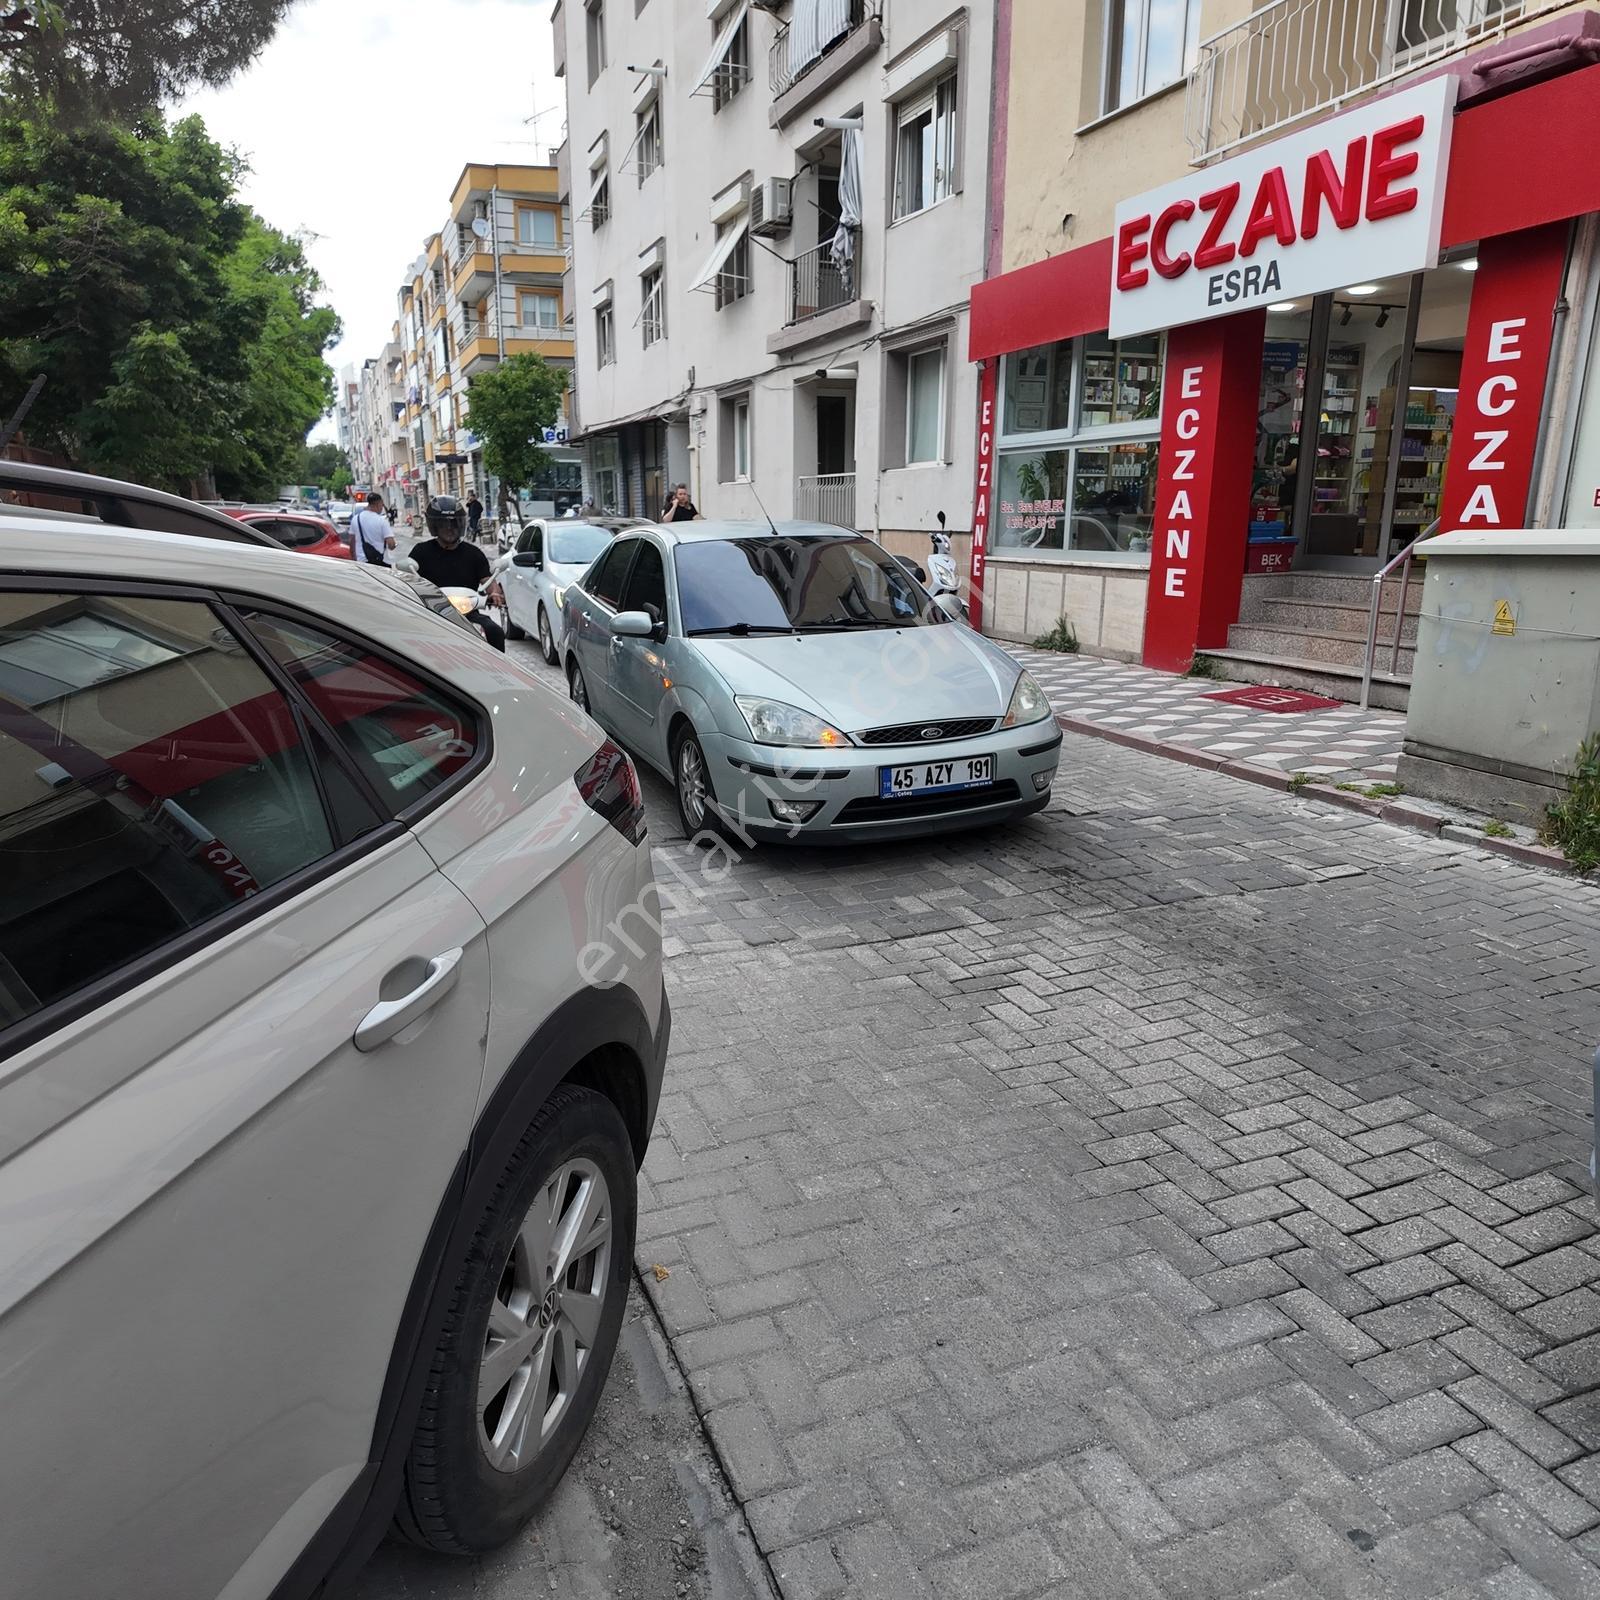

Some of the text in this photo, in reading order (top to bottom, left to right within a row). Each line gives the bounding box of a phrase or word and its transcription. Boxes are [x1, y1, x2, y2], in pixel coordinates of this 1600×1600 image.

[1116, 114, 1425, 292] ECZANE
[1208, 260, 1282, 306] ESRA
[973, 401, 991, 577] ECZANE
[1164, 366, 1204, 598] ECZANE
[1261, 554, 1282, 566] BEK
[893, 769, 914, 789] 45
[925, 763, 954, 786] AZY
[967, 758, 990, 780] 191
